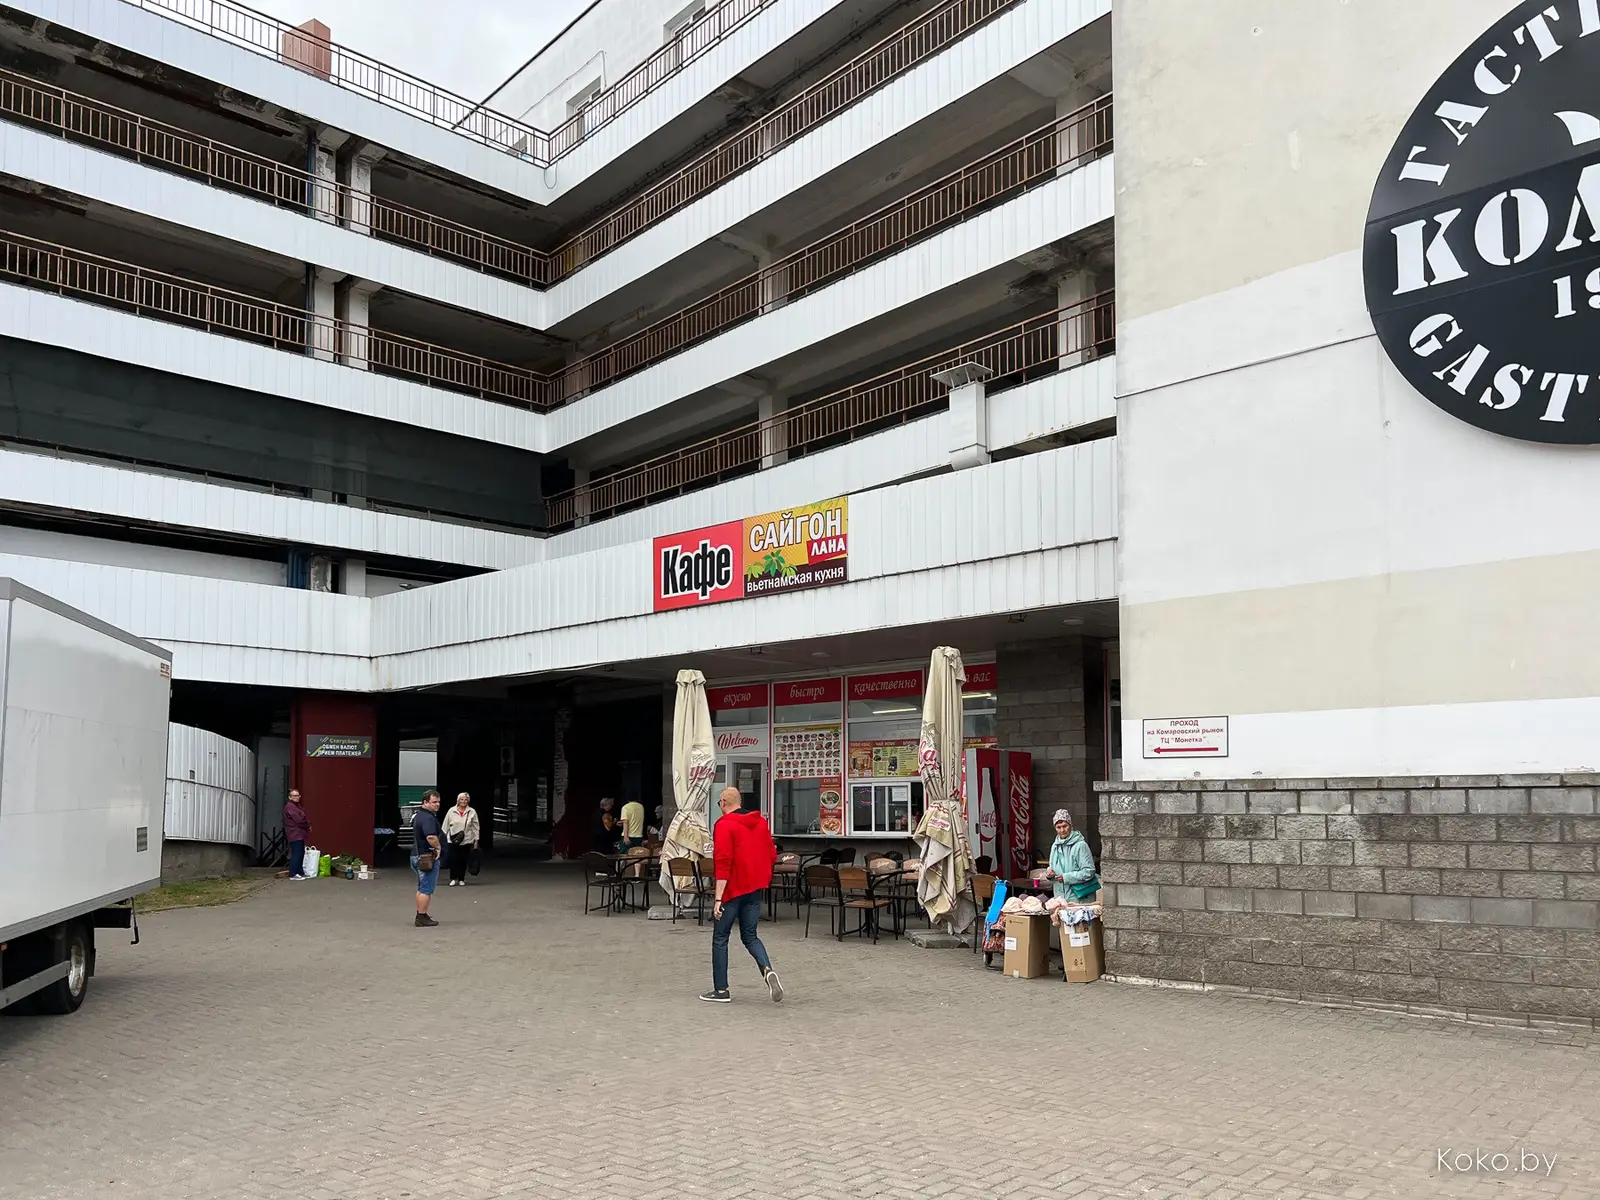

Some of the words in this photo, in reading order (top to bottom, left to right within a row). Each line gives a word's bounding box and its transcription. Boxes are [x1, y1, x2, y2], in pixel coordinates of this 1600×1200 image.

[1409, 313, 1600, 422] GAST
[750, 508, 842, 552] САЙГОН
[811, 540, 846, 557] ЛАНА
[662, 540, 733, 599] Кафе
[746, 571, 813, 593] вьетнамская
[814, 566, 844, 584] кухня
[972, 671, 991, 682] вас
[789, 684, 825, 701] быстро
[854, 678, 917, 696] качественно
[723, 692, 752, 706] вкусно
[1156, 727, 1200, 735] Комаровский
[717, 731, 759, 751] Welcome
[1010, 768, 1030, 872] Coca-Cola
